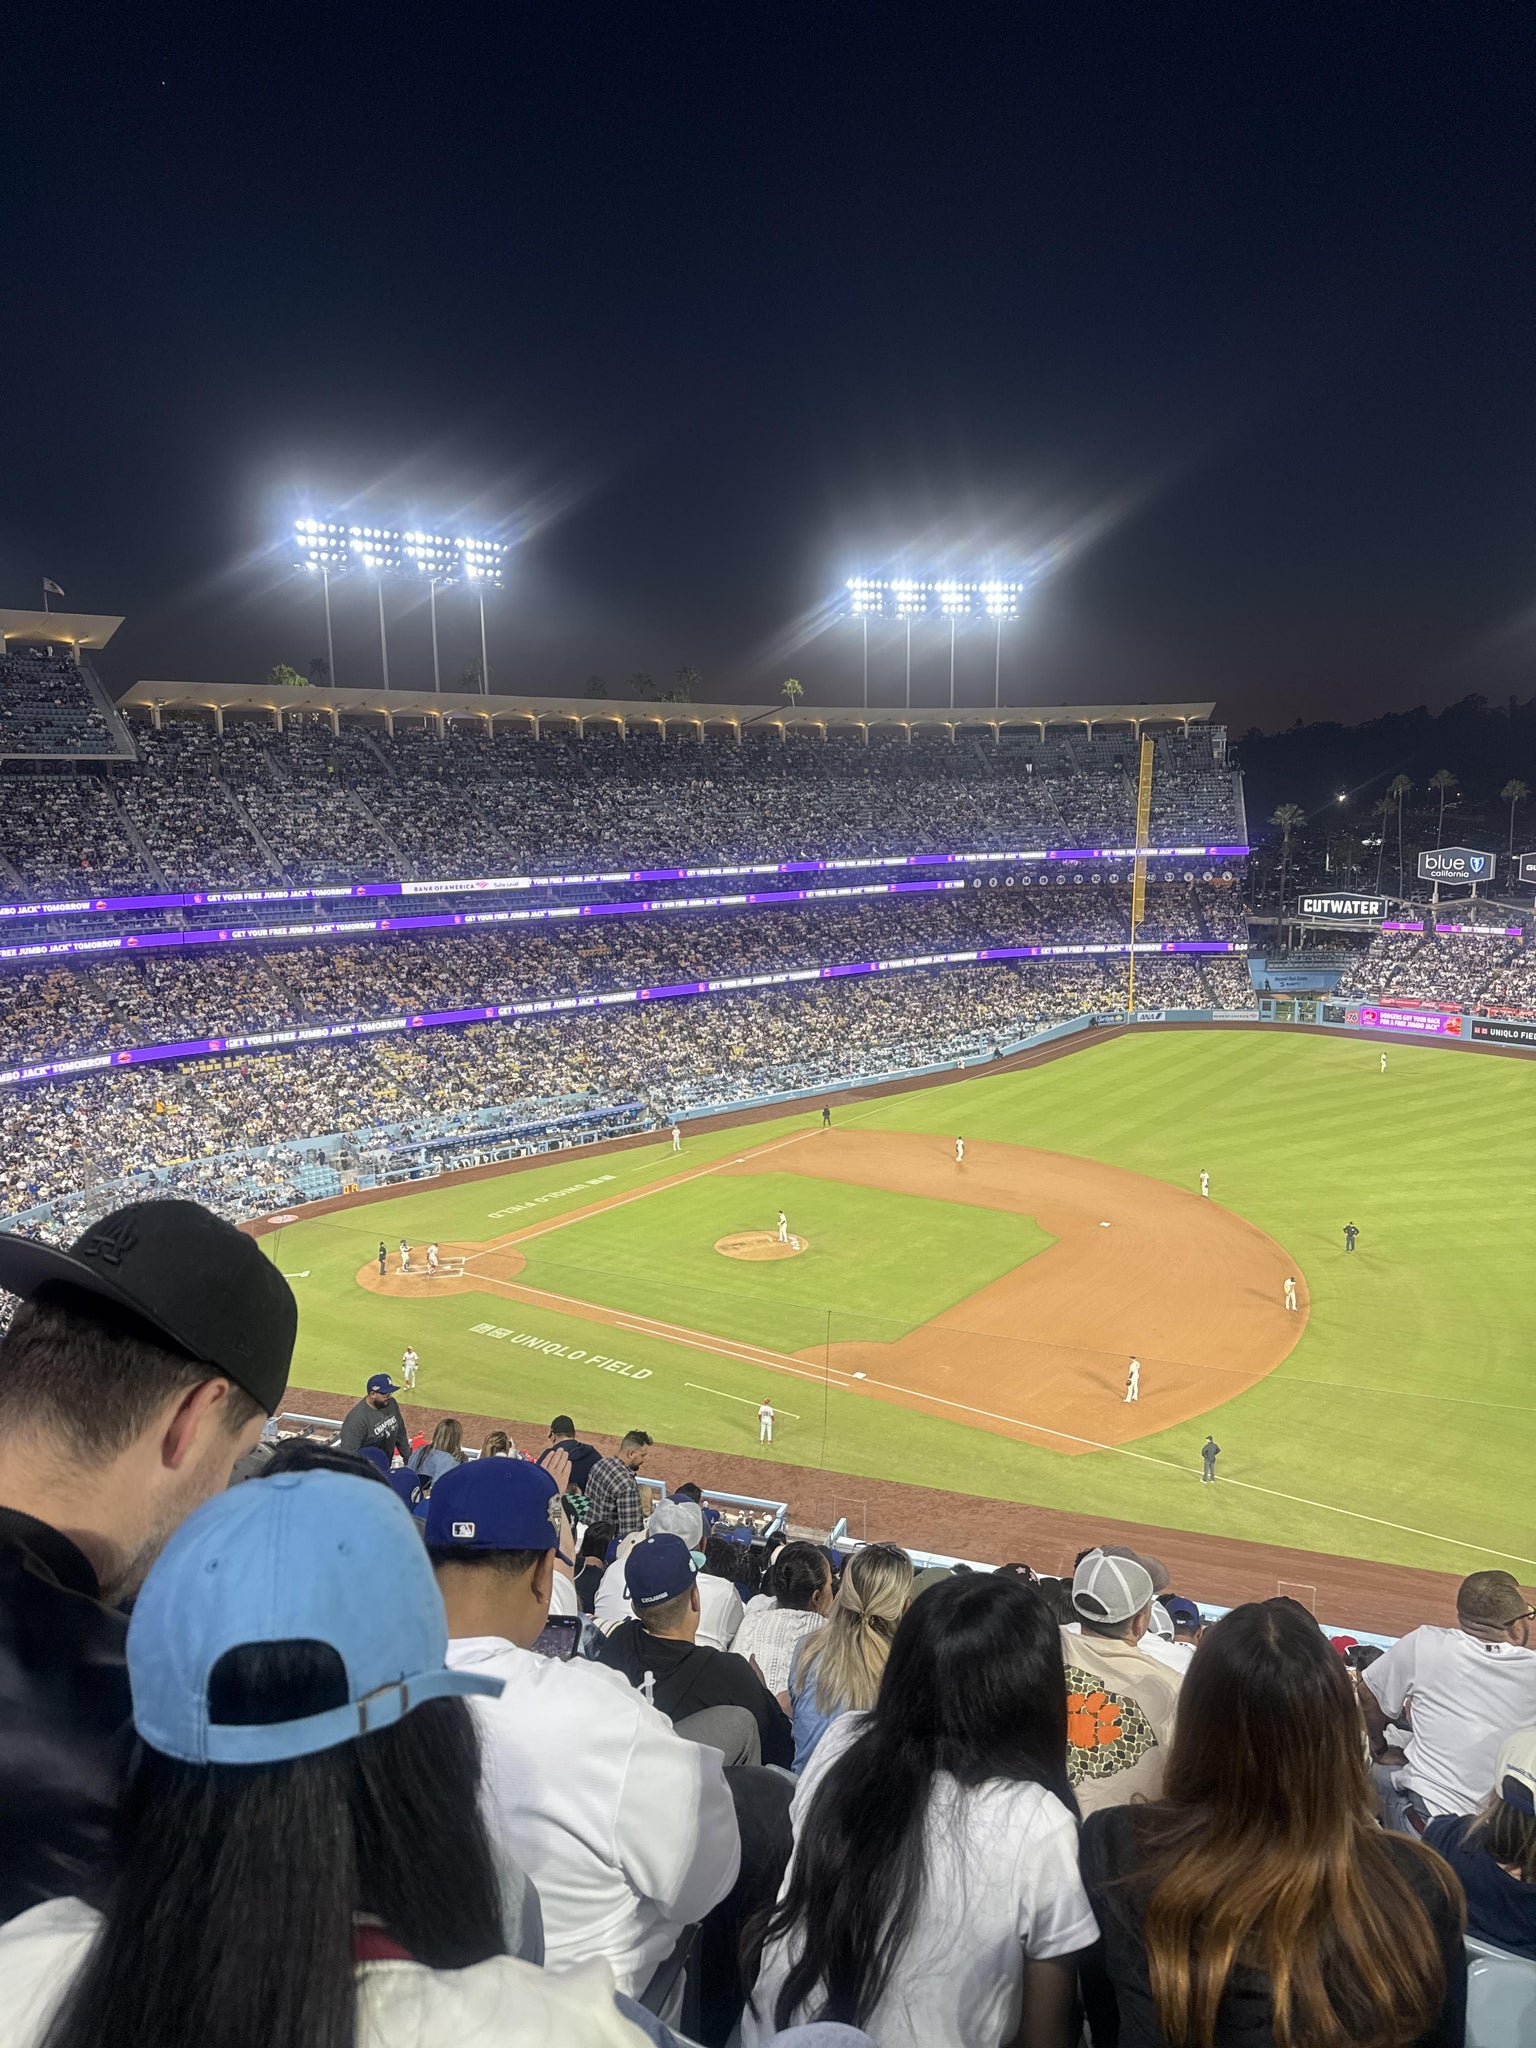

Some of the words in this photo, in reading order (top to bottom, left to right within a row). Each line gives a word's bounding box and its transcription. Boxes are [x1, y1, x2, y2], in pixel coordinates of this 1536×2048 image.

[1425, 854, 1465, 870] blue
[1430, 870, 1469, 878] california
[207, 894, 222, 902] GET
[222, 893, 243, 901] YOUR
[244, 892, 262, 900] FREE
[263, 891, 289, 899] JUMBO
[311, 888, 352, 896] TOMORROW
[42, 902, 90, 912] TOMORROW
[1303, 899, 1379, 915] CUTWATER
[232, 930, 246, 938] GET
[247, 929, 268, 937] YOUR
[269, 928, 287, 936] FREE
[288, 926, 314, 935] JUMBO
[335, 922, 377, 932] TOMORROW
[19, 946, 47, 955] JUMBO
[73, 939, 121, 950] TOMORROW
[514, 1005, 533, 1013] YOUR
[552, 1000, 577, 1009] JUMBO
[598, 992, 637, 1003] TOMORROW
[226, 1038, 245, 1048] GET
[246, 1035, 272, 1045] YOUR
[273, 1032, 296, 1042] FREE
[297, 1028, 329, 1039] JUMBO
[356, 1019, 407, 1032] TOMORROW
[1490, 1028, 1518, 1038] UNIQLO
[1520, 1031, 1536, 1040] FIEL
[0, 1071, 20, 1082] MBO
[52, 1056, 112, 1073] TOMORROW
[488, 1201, 536, 1219] FIELD
[510, 1333, 587, 1361] UNIQLO
[584, 1355, 654, 1380] FIELD
